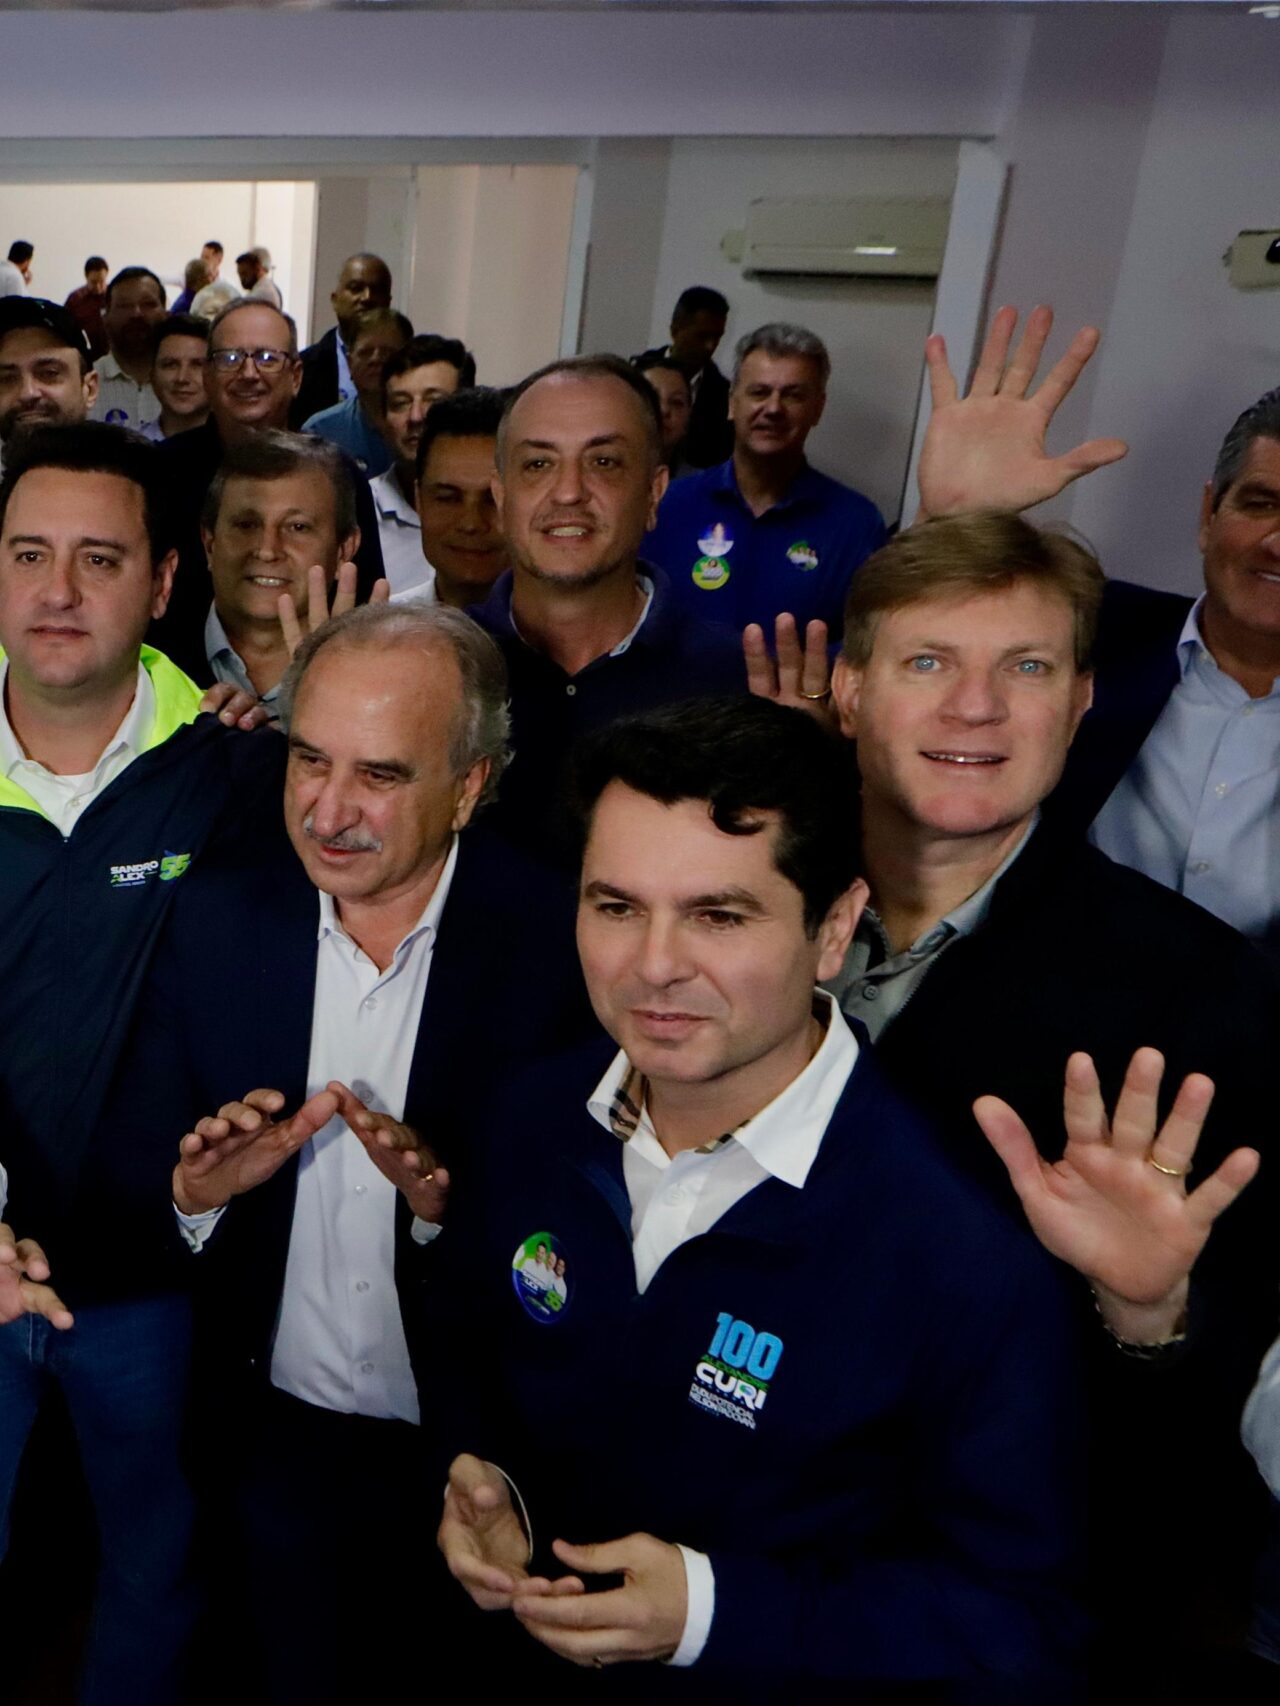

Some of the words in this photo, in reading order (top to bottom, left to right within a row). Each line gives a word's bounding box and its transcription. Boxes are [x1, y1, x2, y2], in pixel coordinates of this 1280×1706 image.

[110, 861, 159, 875] SANDRO
[160, 853, 191, 881] 55
[707, 1312, 784, 1381] 100
[695, 1362, 768, 1411] CURI
